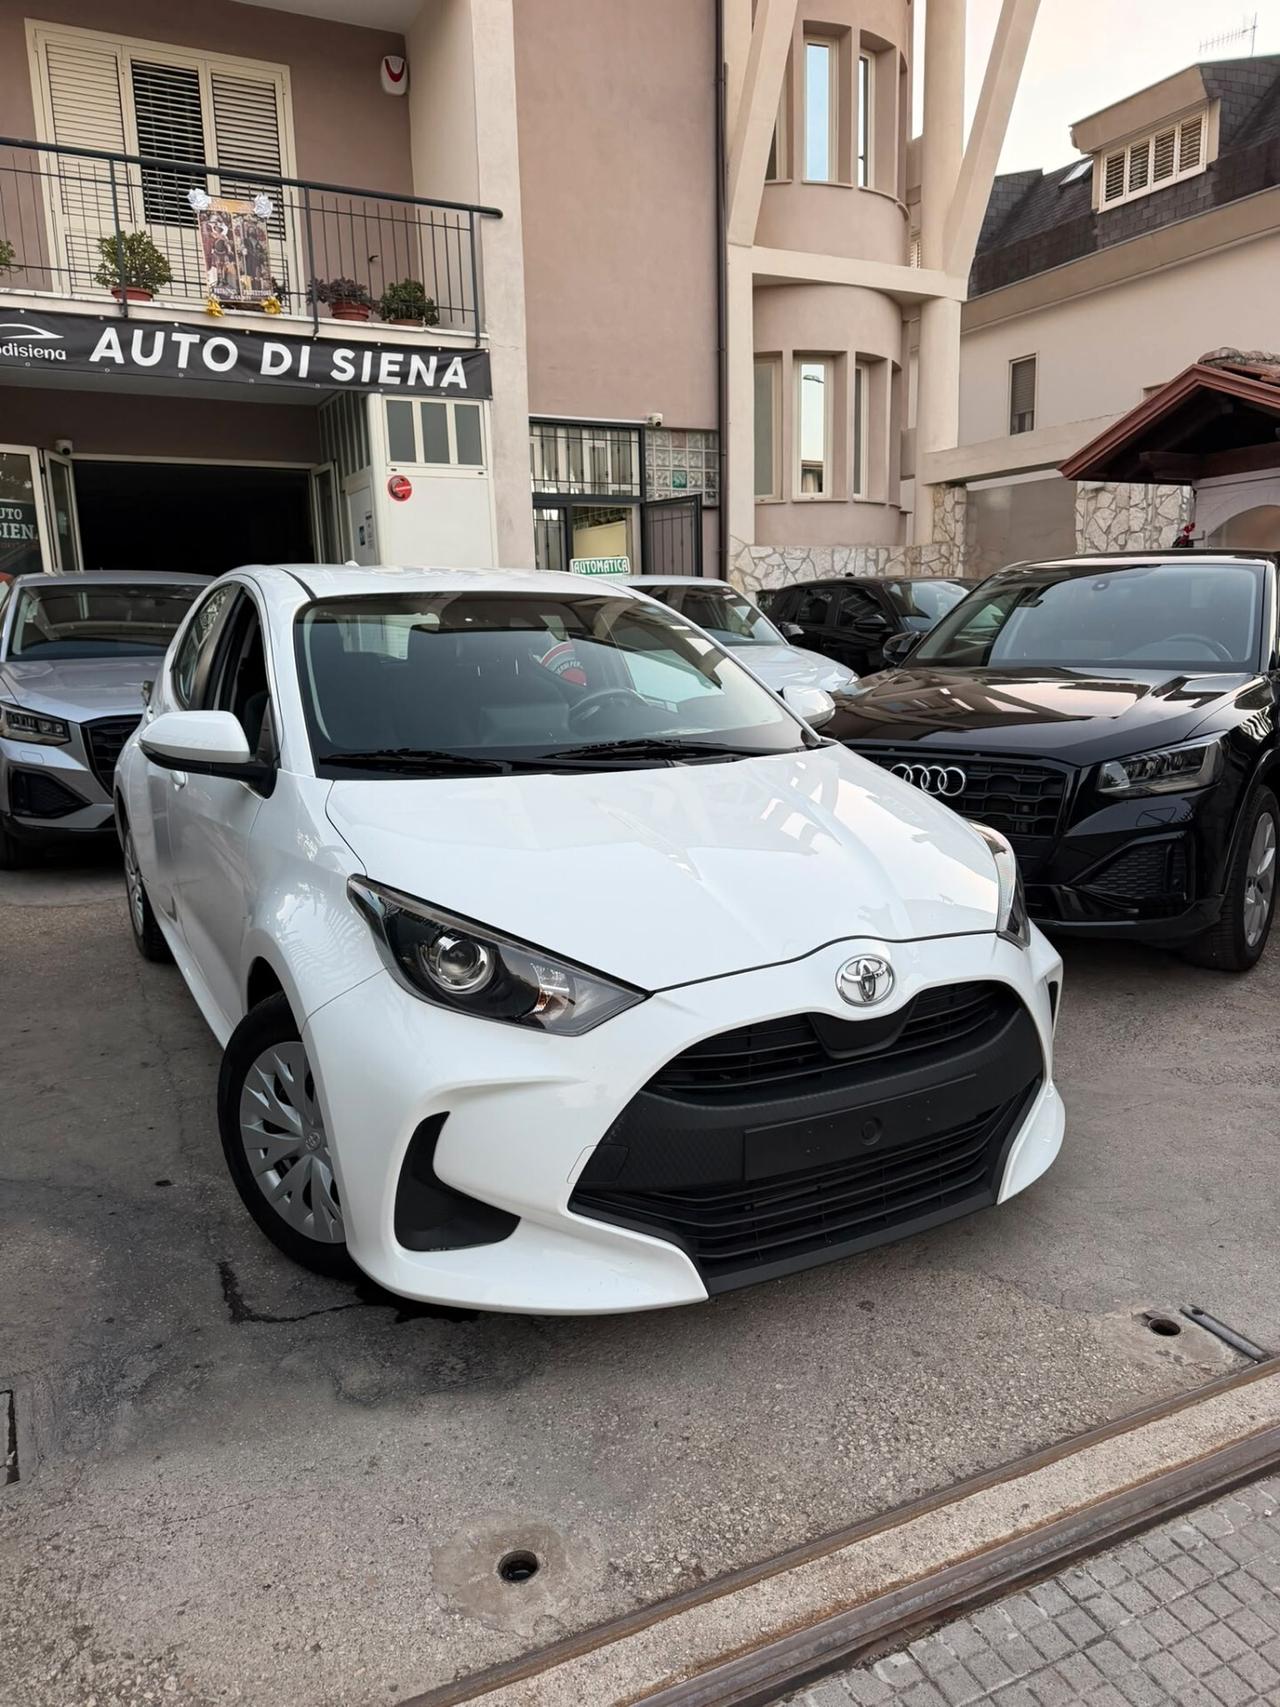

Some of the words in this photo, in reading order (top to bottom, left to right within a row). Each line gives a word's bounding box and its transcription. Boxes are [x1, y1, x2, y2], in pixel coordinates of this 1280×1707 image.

[89, 327, 239, 372] AUTO
[260, 342, 311, 378] DI
[330, 348, 467, 389] SIENA
[574, 559, 628, 574] AUTOMATICA
